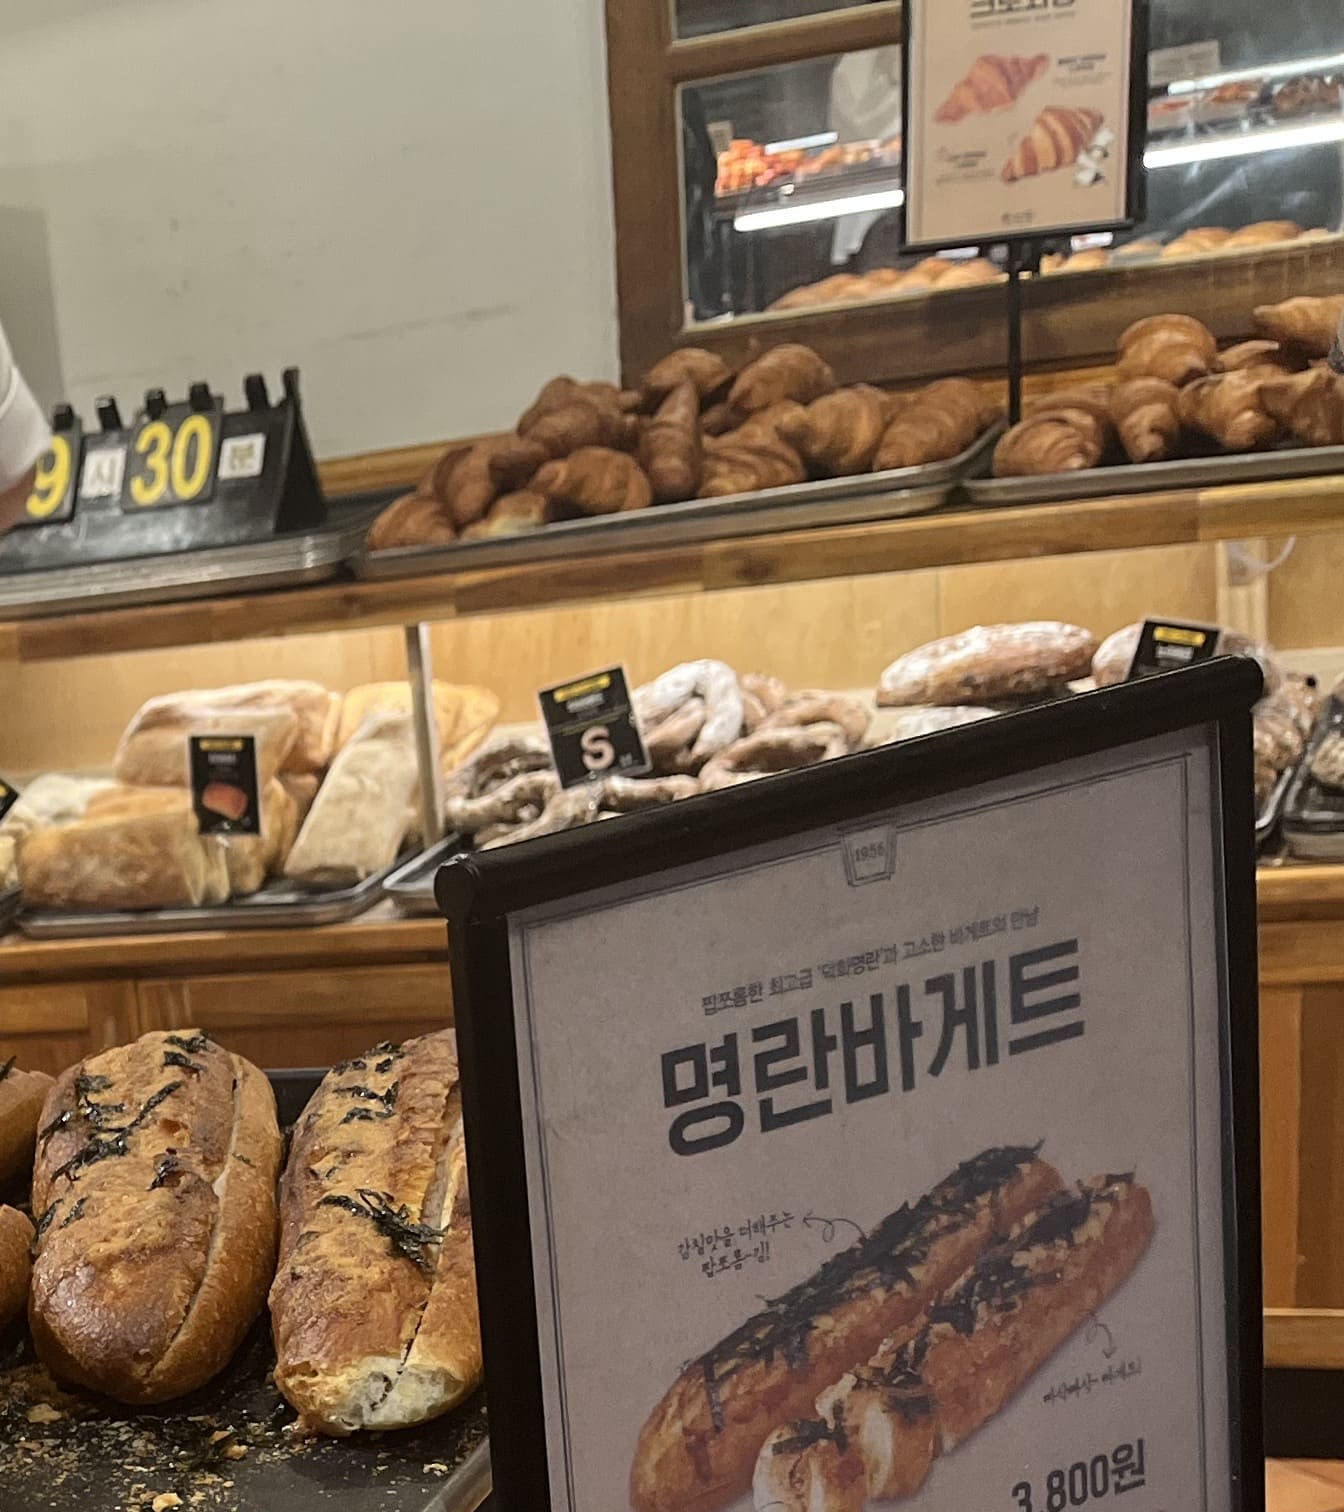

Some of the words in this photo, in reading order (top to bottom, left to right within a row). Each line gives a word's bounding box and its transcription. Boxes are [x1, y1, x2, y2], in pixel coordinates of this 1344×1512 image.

[130, 414, 214, 507] 30
[855, 841, 885, 861] 1956
[903, 931, 946, 960] 고소한
[660, 938, 1086, 1157] 명란바게트
